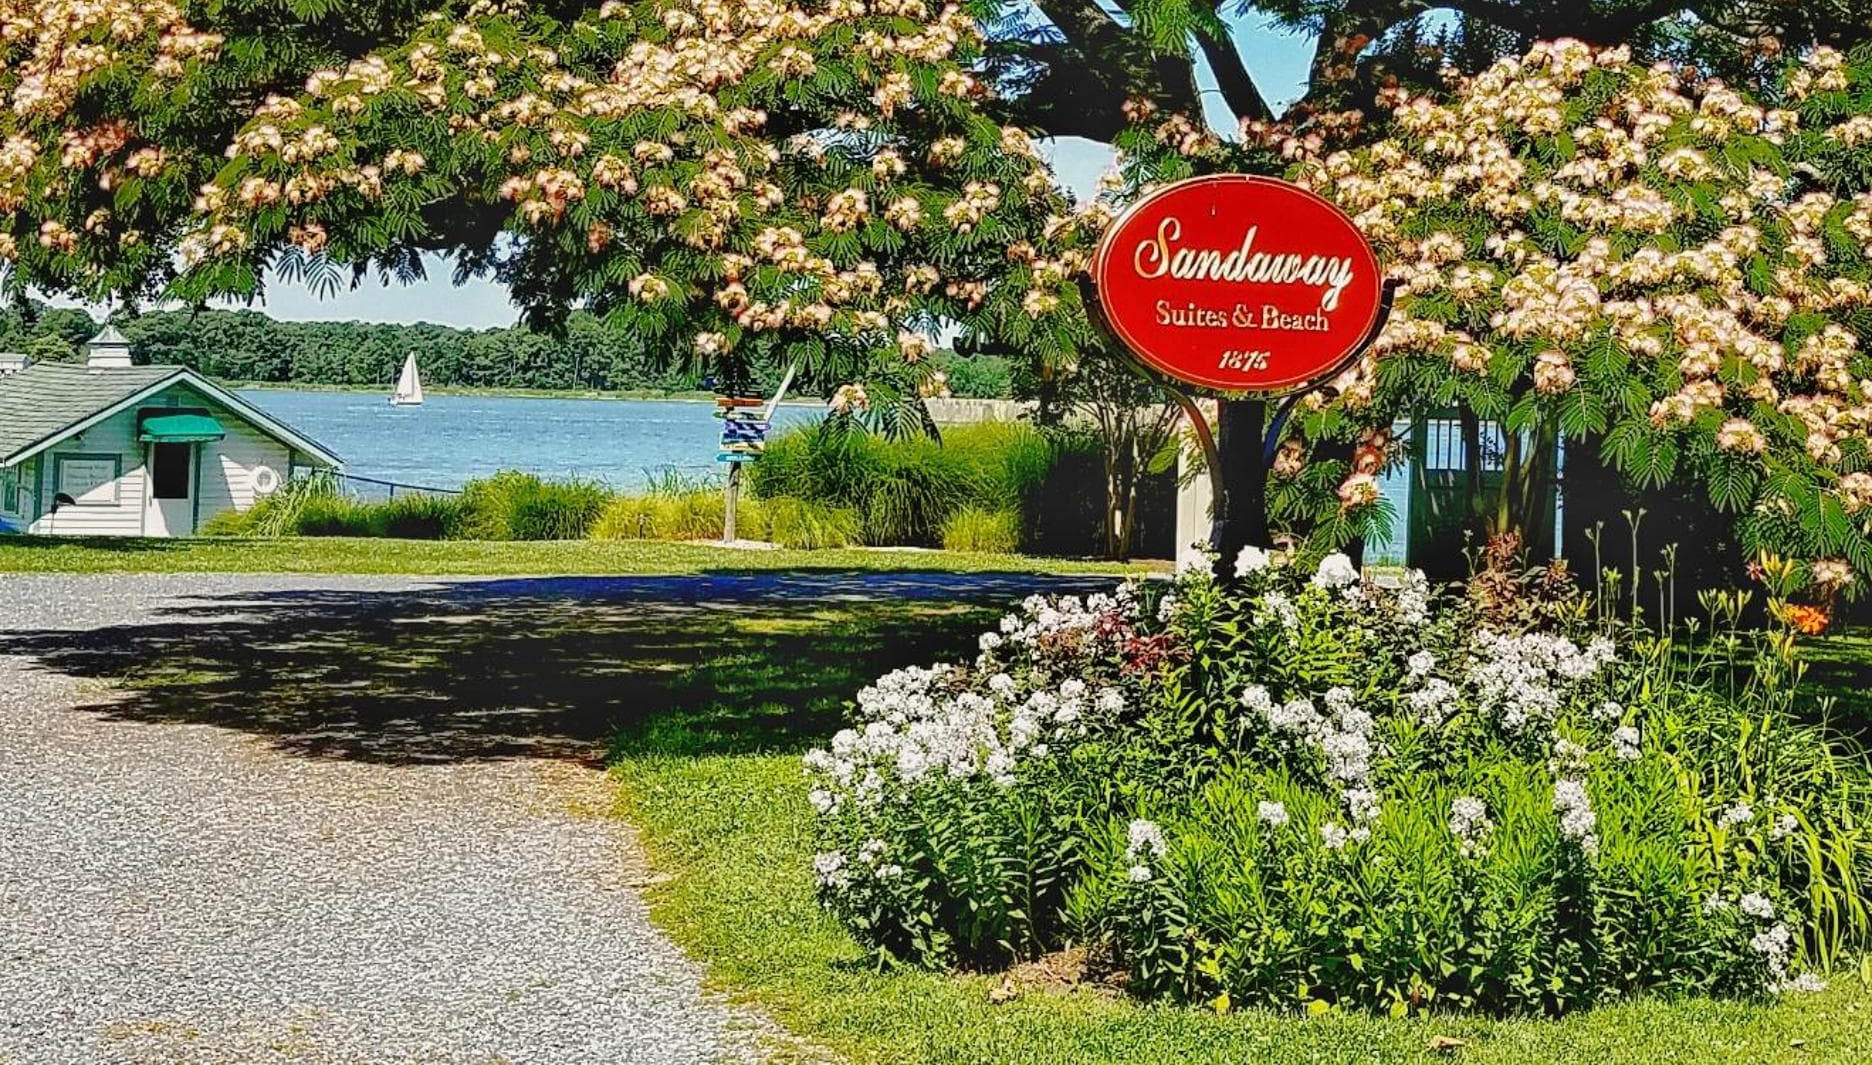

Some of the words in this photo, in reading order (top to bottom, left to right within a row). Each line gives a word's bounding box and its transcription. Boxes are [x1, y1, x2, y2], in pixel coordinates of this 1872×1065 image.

[1134, 217, 1354, 311] Sandaway
[1156, 299, 1227, 328] Suites
[1232, 303, 1258, 328] &
[1261, 304, 1329, 331] Beach
[1218, 350, 1271, 372] 1875
